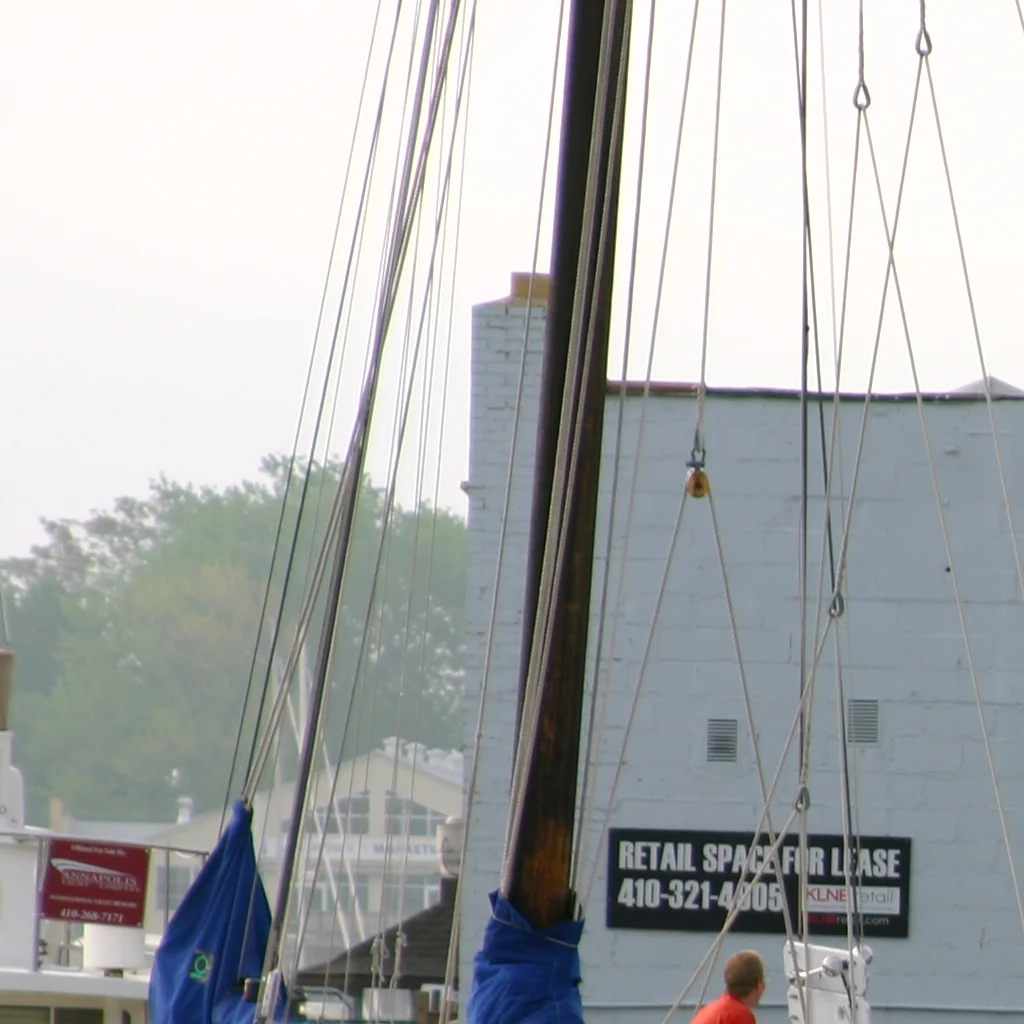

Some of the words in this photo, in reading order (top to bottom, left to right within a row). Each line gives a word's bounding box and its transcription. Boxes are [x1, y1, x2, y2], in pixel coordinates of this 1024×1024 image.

[618, 840, 696, 872] RETAIL
[703, 843, 776, 875] SPACE
[782, 845, 825, 876] FOR
[61, 870, 137, 886] ANNAPOLIS
